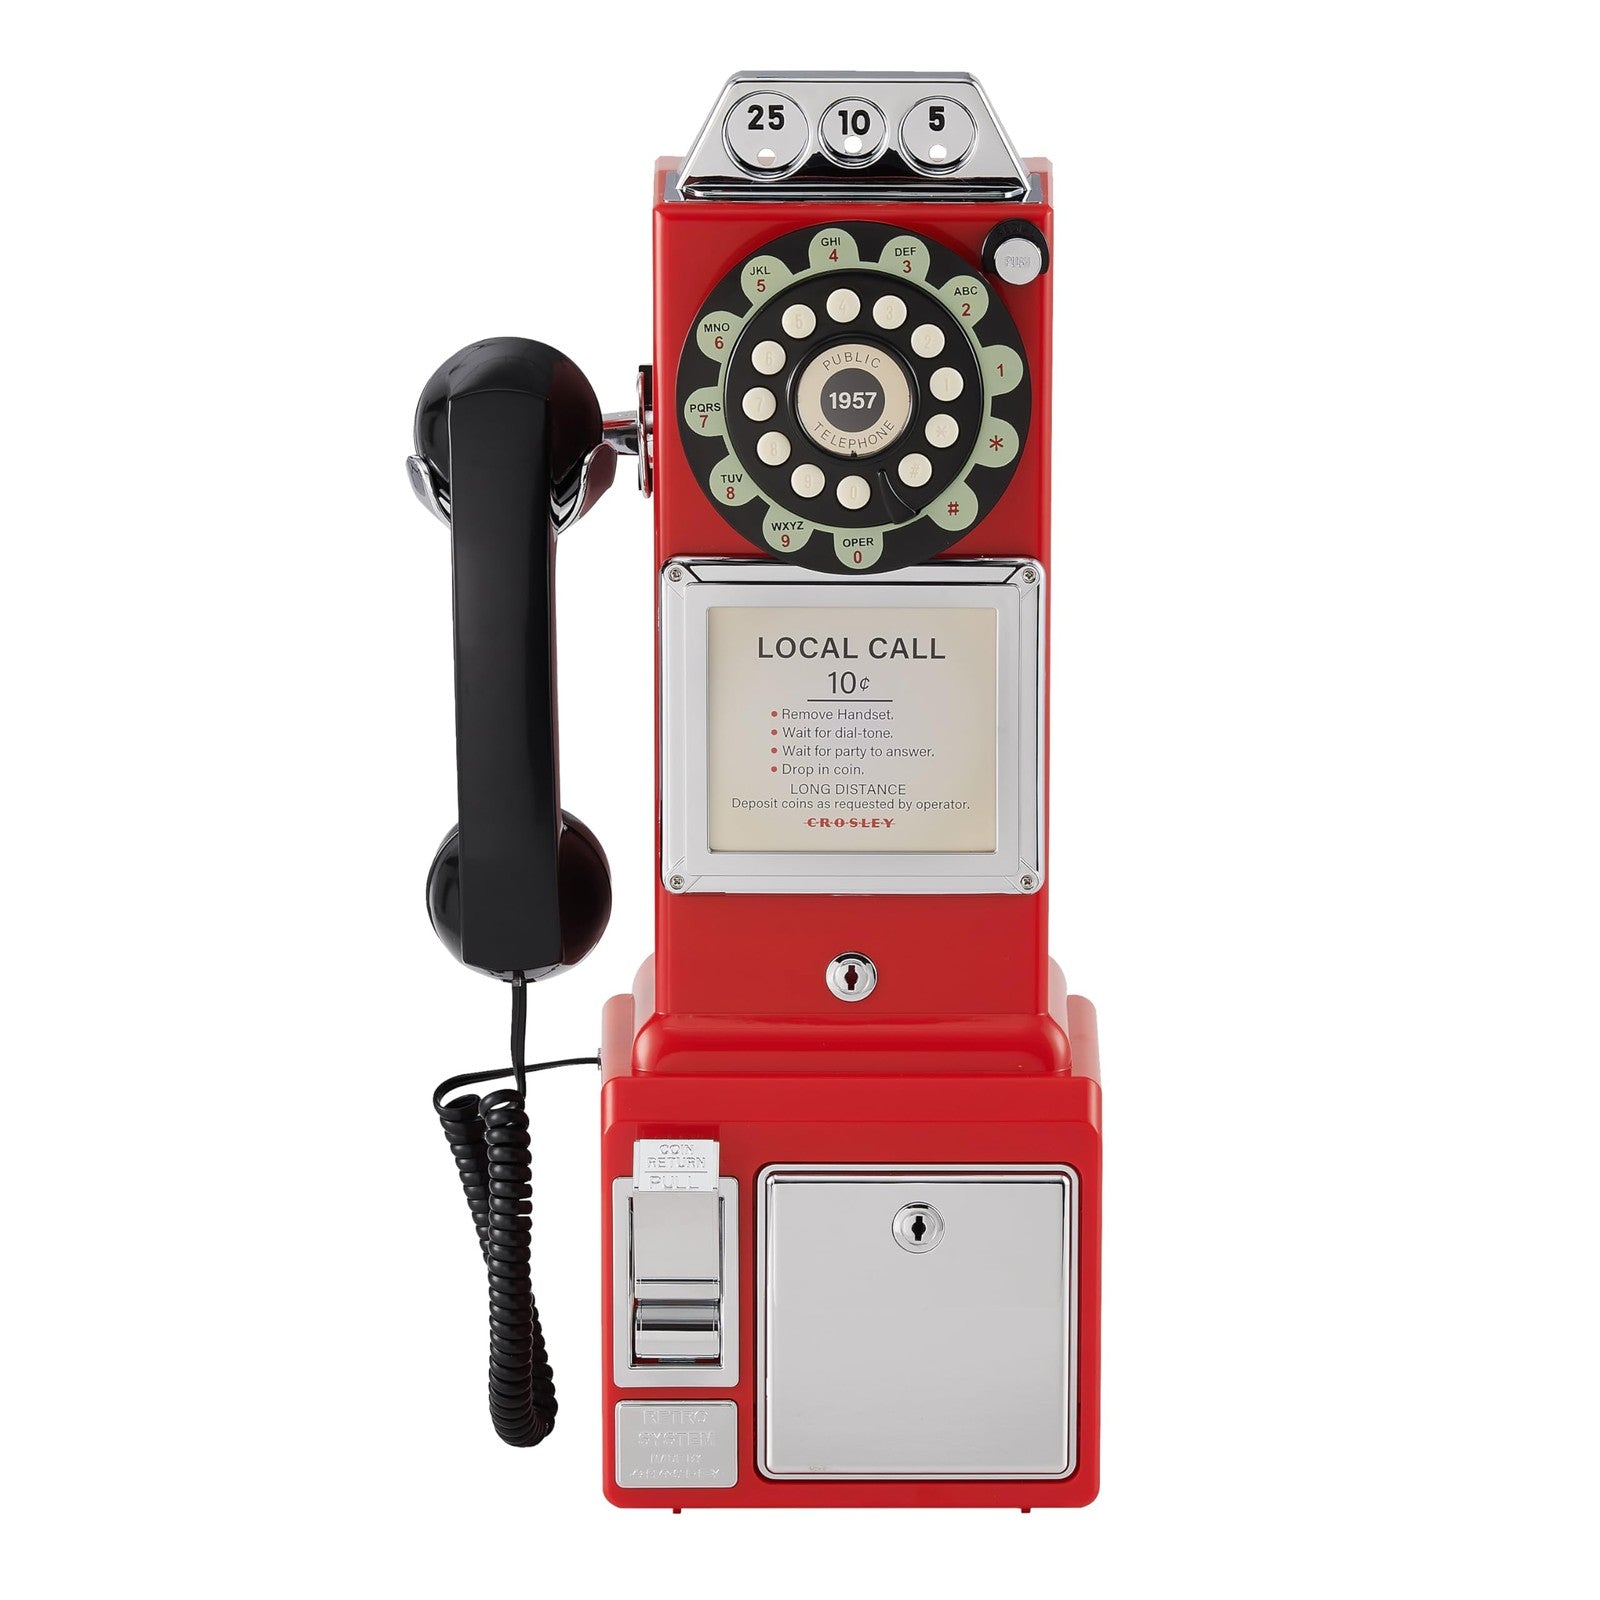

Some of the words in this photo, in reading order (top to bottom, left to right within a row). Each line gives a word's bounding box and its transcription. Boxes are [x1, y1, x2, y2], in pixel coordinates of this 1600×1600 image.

[748, 105, 784, 130] 25
[838, 110, 870, 135] 10
[929, 106, 945, 131] 5
[821, 237, 840, 246] GHI
[829, 249, 838, 262] 4
[895, 247, 916, 256] DEF
[750, 266, 770, 275] JKL
[903, 260, 912, 273] 3
[757, 279, 766, 292] 5
[954, 286, 977, 295] ABC
[962, 303, 971, 316] 2
[704, 323, 730, 332] MNO
[715, 337, 723, 349] 6
[823, 352, 880, 370] PUBLIC
[997, 364, 1003, 377] 1
[829, 392, 877, 409] 1957
[690, 403, 721, 412] PQRS
[700, 415, 708, 428] 7
[814, 420, 894, 448] TELEPHONE
[721, 474, 743, 483] TUV
[726, 487, 735, 499] 8
[772, 521, 804, 531] WXYZ
[781, 535, 790, 547] 9
[843, 538, 874, 547] OPER
[854, 551, 862, 563] 0
[758, 637, 858, 659] LOCAL
[869, 637, 946, 659] CALL
[828, 671, 869, 694] 10¢
[782, 709, 833, 720] Remove
[838, 709, 894, 720] Handset.
[783, 727, 811, 738] Wait
[815, 727, 831, 738] for
[835, 727, 893, 739] dial-tone.
[783, 745, 811, 757] Wait
[815, 745, 831, 757] for
[835, 746, 866, 759] party
[871, 746, 882, 757] to
[886, 748, 934, 757] answer.
[782, 764, 814, 777] Drop
[819, 764, 829, 775] in
[834, 764, 864, 775] coin.
[791, 784, 831, 795] LONG
[836, 784, 906, 795] DISTANCE
[732, 798, 777, 810] Deposit
[782, 799, 813, 809] coins
[817, 801, 830, 809] as
[835, 799, 894, 811] requested
[899, 799, 912, 811] by
[916, 800, 970, 811] operator.
[807, 818, 894, 828] CROSLEY
[660, 1144, 694, 1155] COIN
[648, 1157, 705, 1168] RETURN
[650, 1176, 699, 1189] PULL
[644, 1411, 708, 1424] RETRO
[639, 1432, 713, 1445] SYSTEM
